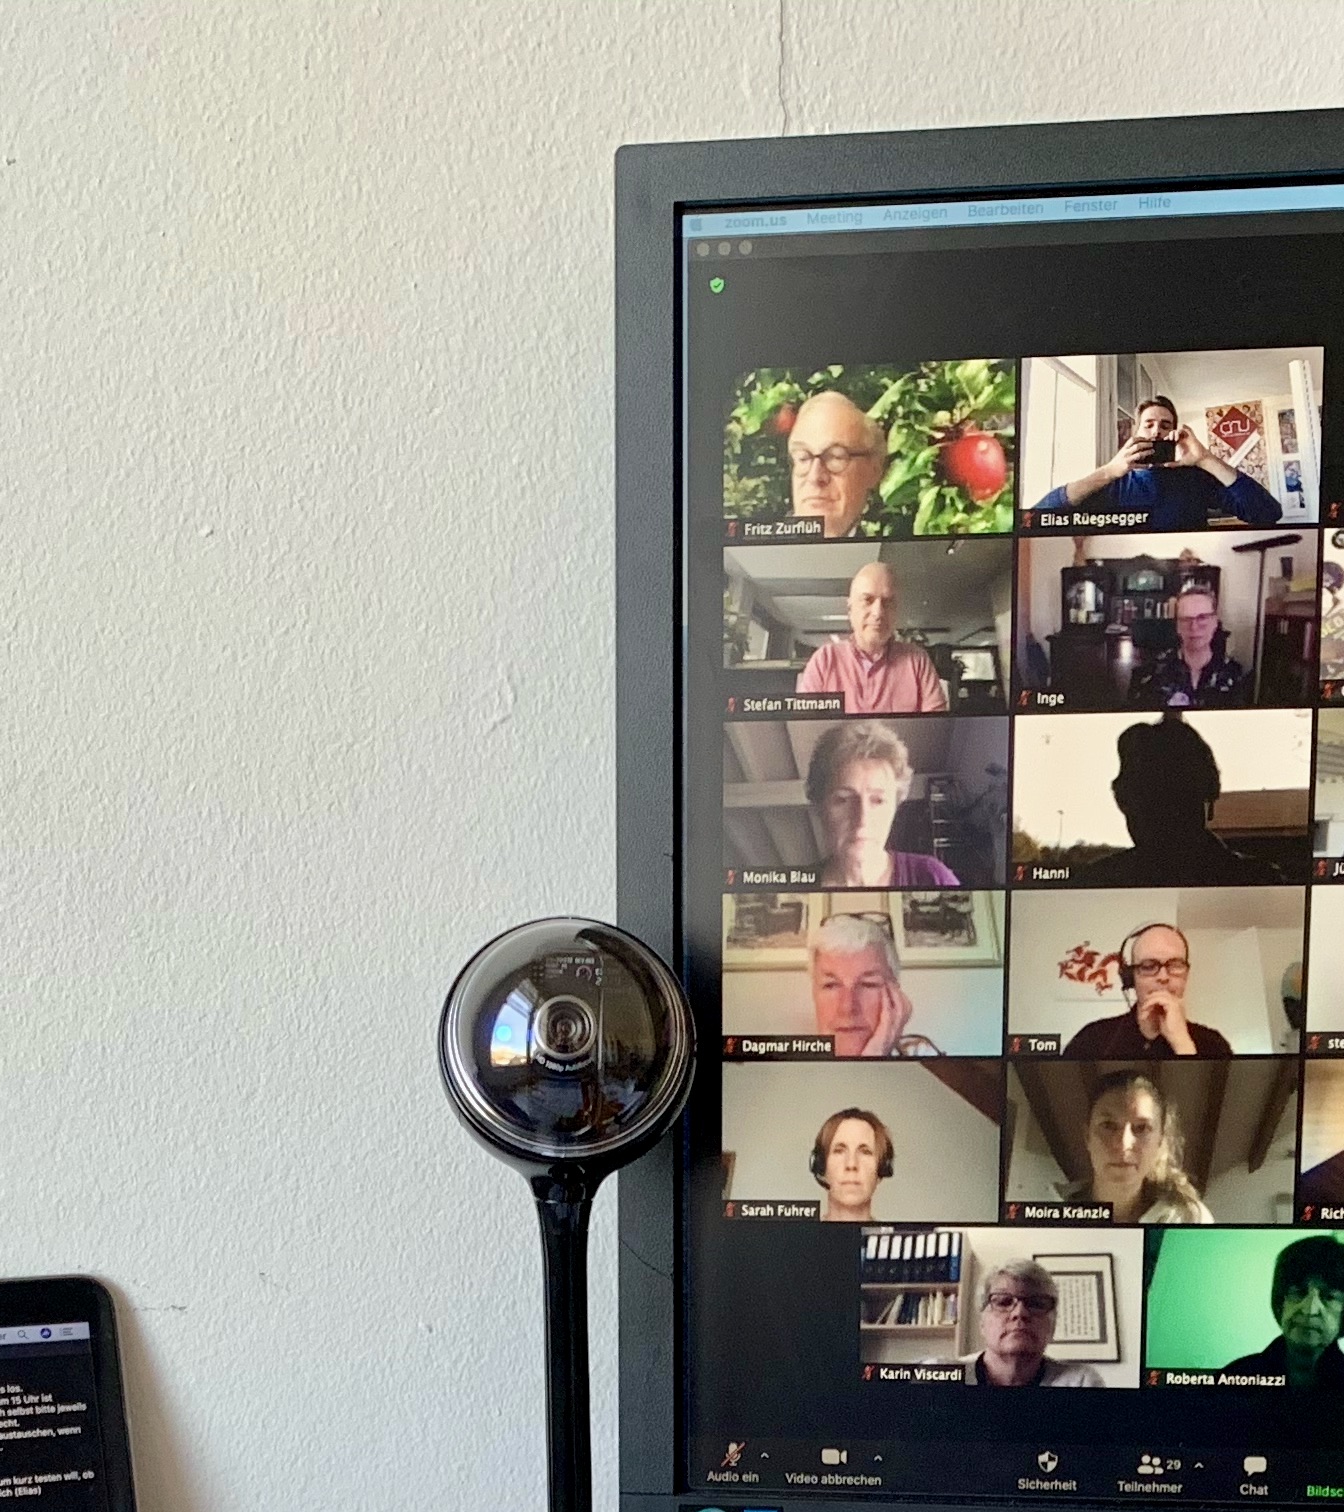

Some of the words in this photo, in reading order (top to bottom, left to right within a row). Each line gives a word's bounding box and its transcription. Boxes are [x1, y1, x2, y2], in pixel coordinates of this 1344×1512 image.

[1040, 513, 1070, 527] Elias
[1072, 512, 1149, 528] Rüegsegger
[744, 522, 773, 536] Fritz
[775, 520, 822, 535] Zurflüh
[743, 697, 782, 712] Stefan
[784, 697, 841, 711] Tittmann
[1036, 692, 1065, 707] Inge
[742, 870, 787, 884] Monika
[790, 870, 816, 884] Blau
[1032, 866, 1070, 880] Hanni
[742, 1039, 790, 1055] Dagmar
[792, 1039, 832, 1052] Hirche
[1028, 1038, 1057, 1052] Tom
[741, 1204, 774, 1217] Sarah
[777, 1204, 817, 1217] Fuhrer
[1024, 1206, 1061, 1219] Moira
[1062, 1206, 1111, 1219] Kränzle
[879, 1367, 911, 1380] Karin
[913, 1368, 962, 1381] Viscardi
[1166, 1372, 1215, 1386] Roberta
[1217, 1373, 1286, 1387] Antoniazzi
[1166, 1459, 1182, 1471] 29
[706, 1470, 740, 1483] Audio
[741, 1471, 760, 1483] ein
[784, 1472, 819, 1485] Video
[820, 1473, 882, 1486] abbrechen
[1017, 1477, 1077, 1491] Sicherheit
[1117, 1480, 1183, 1494] Teilnehmer
[1239, 1483, 1269, 1496] Chat
